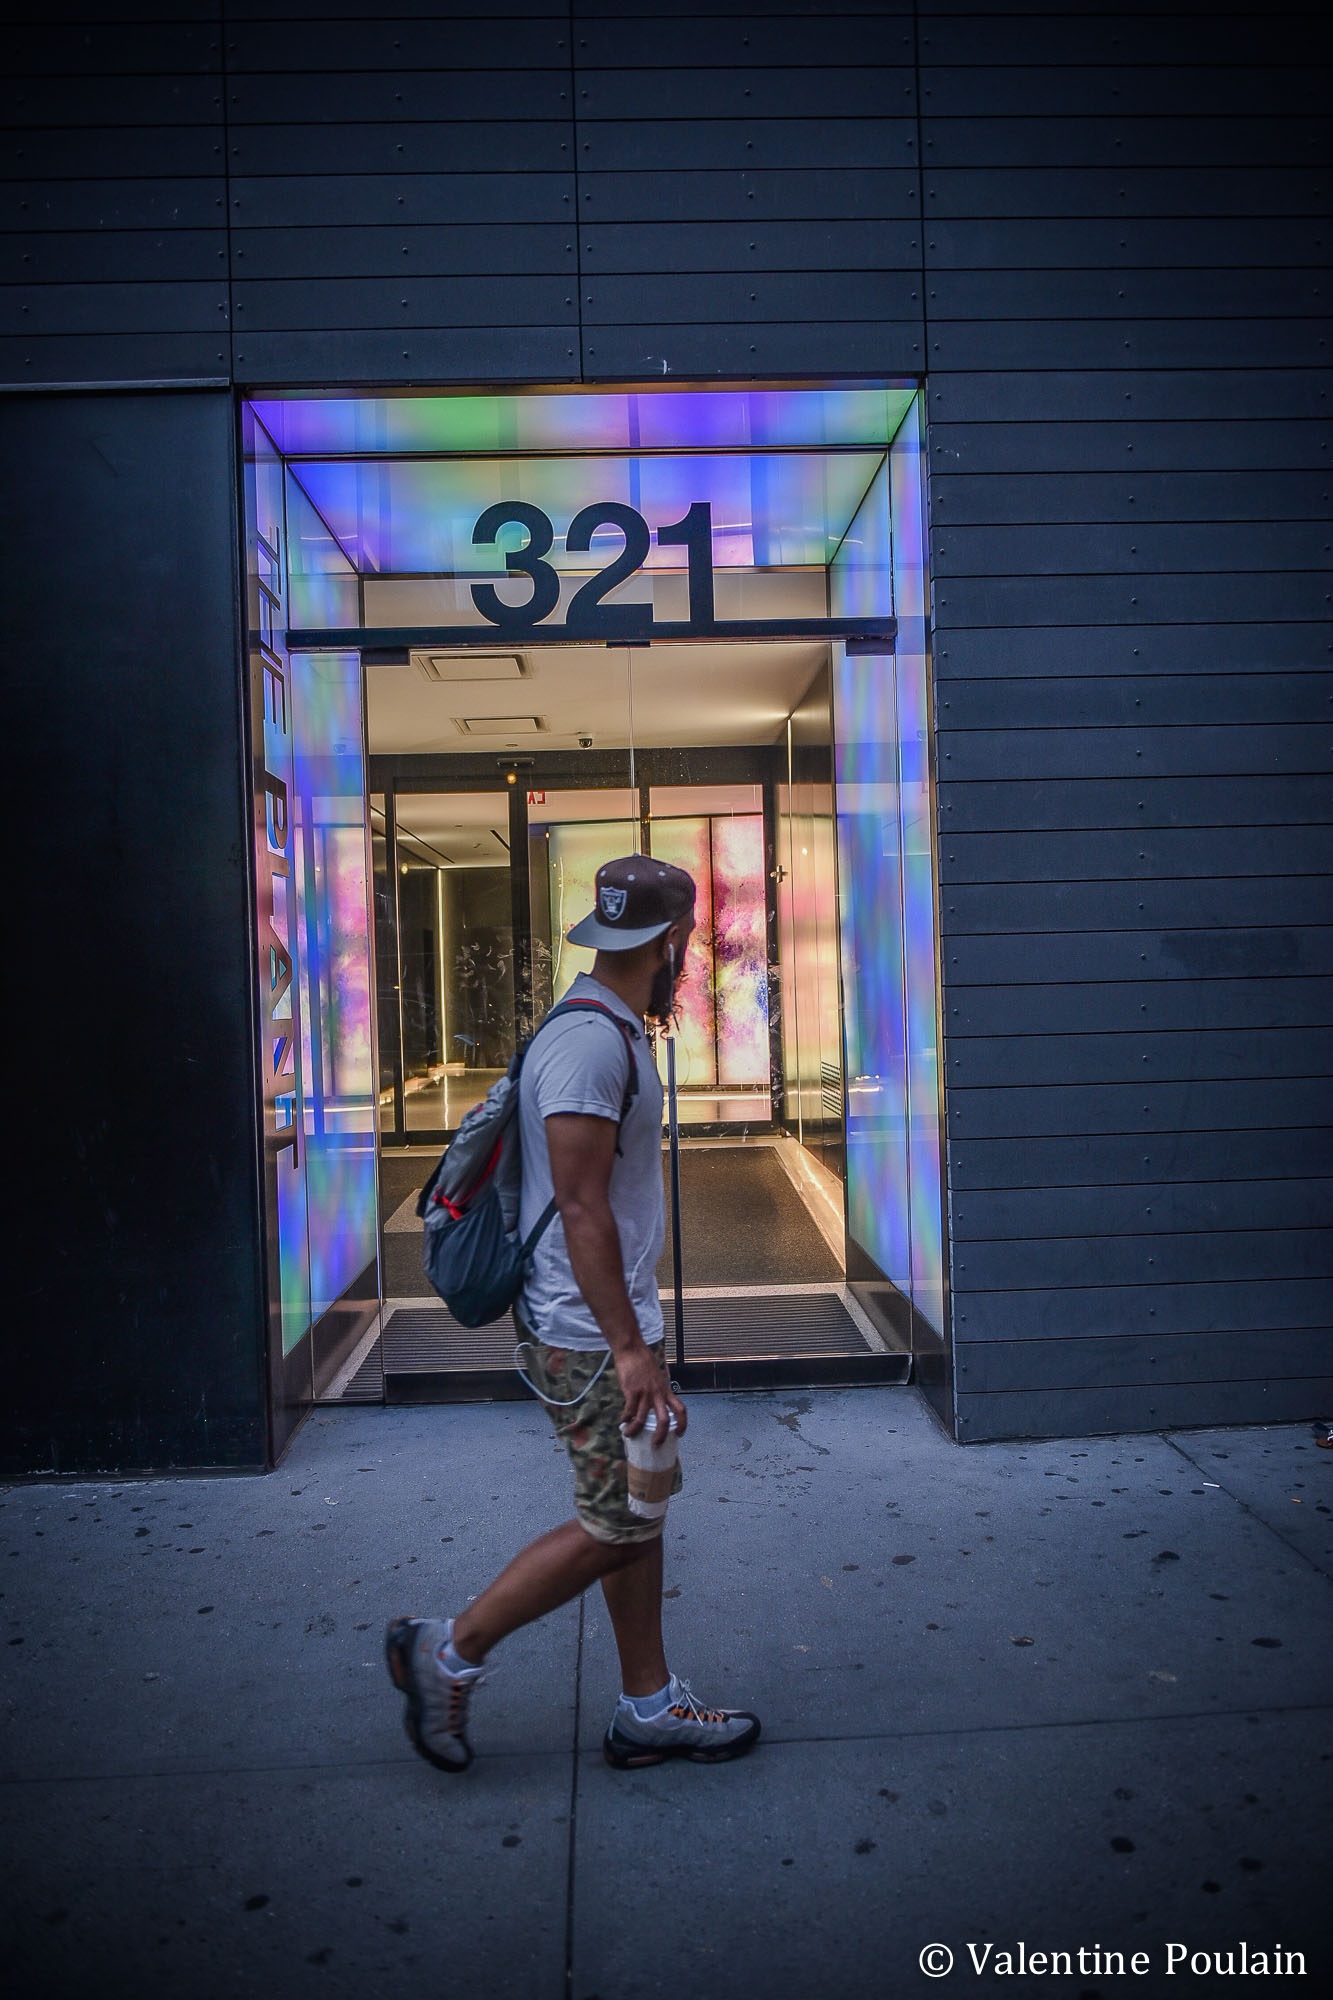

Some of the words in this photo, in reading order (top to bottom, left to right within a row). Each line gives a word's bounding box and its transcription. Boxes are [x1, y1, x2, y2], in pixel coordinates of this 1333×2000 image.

[255, 526, 286, 735] THE
[470, 500, 714, 626] 321
[263, 776, 298, 1169] PLANT
